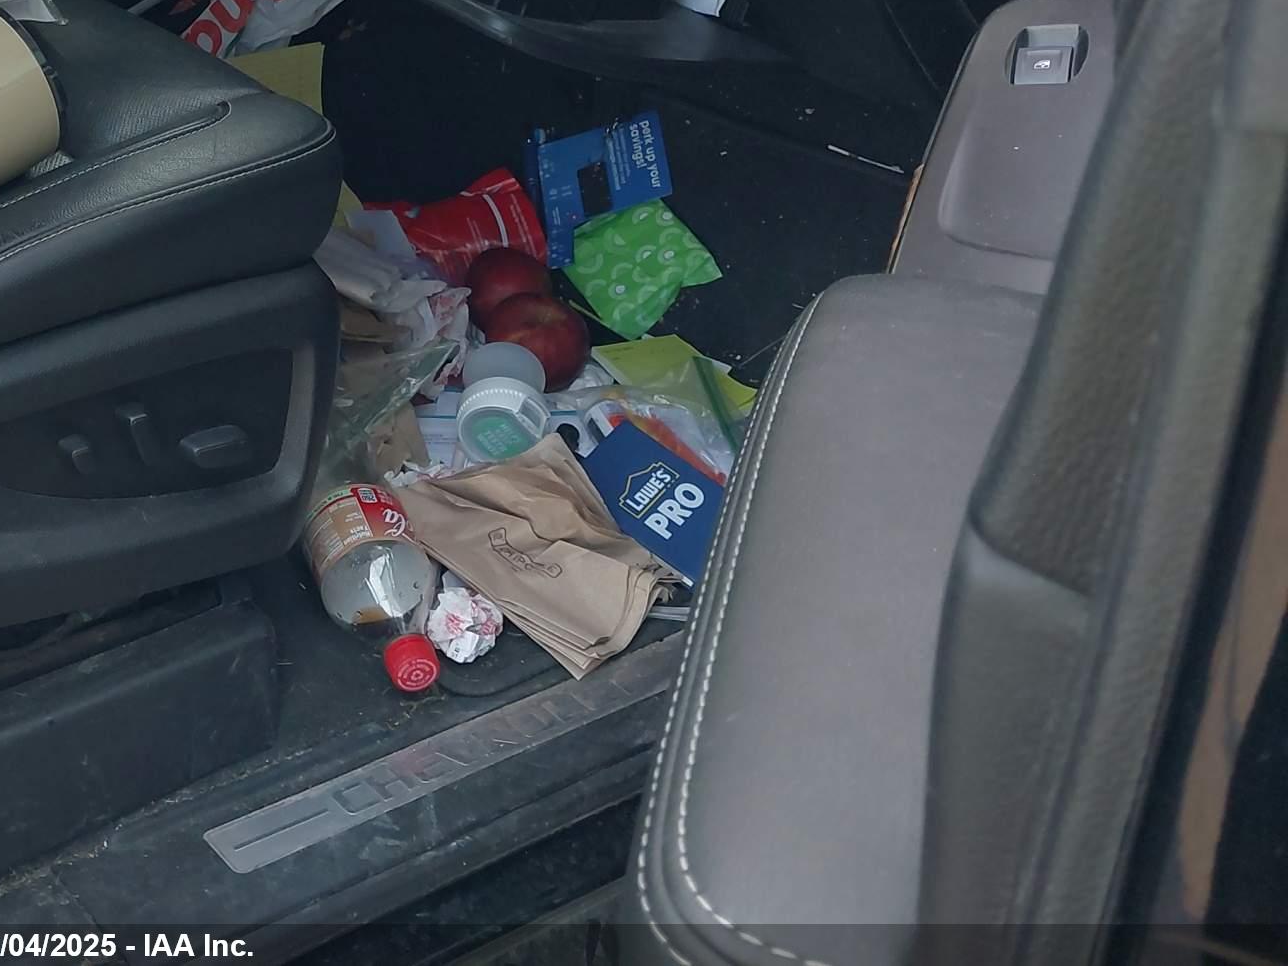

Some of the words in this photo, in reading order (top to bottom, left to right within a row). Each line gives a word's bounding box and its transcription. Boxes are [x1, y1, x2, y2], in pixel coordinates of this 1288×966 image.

[629, 124, 647, 169] savings!
[638, 120, 654, 145] perk
[646, 147, 656, 162] up
[647, 164, 662, 188] your
[625, 467, 672, 512] LOWE'S
[643, 482, 705, 541] PRO
